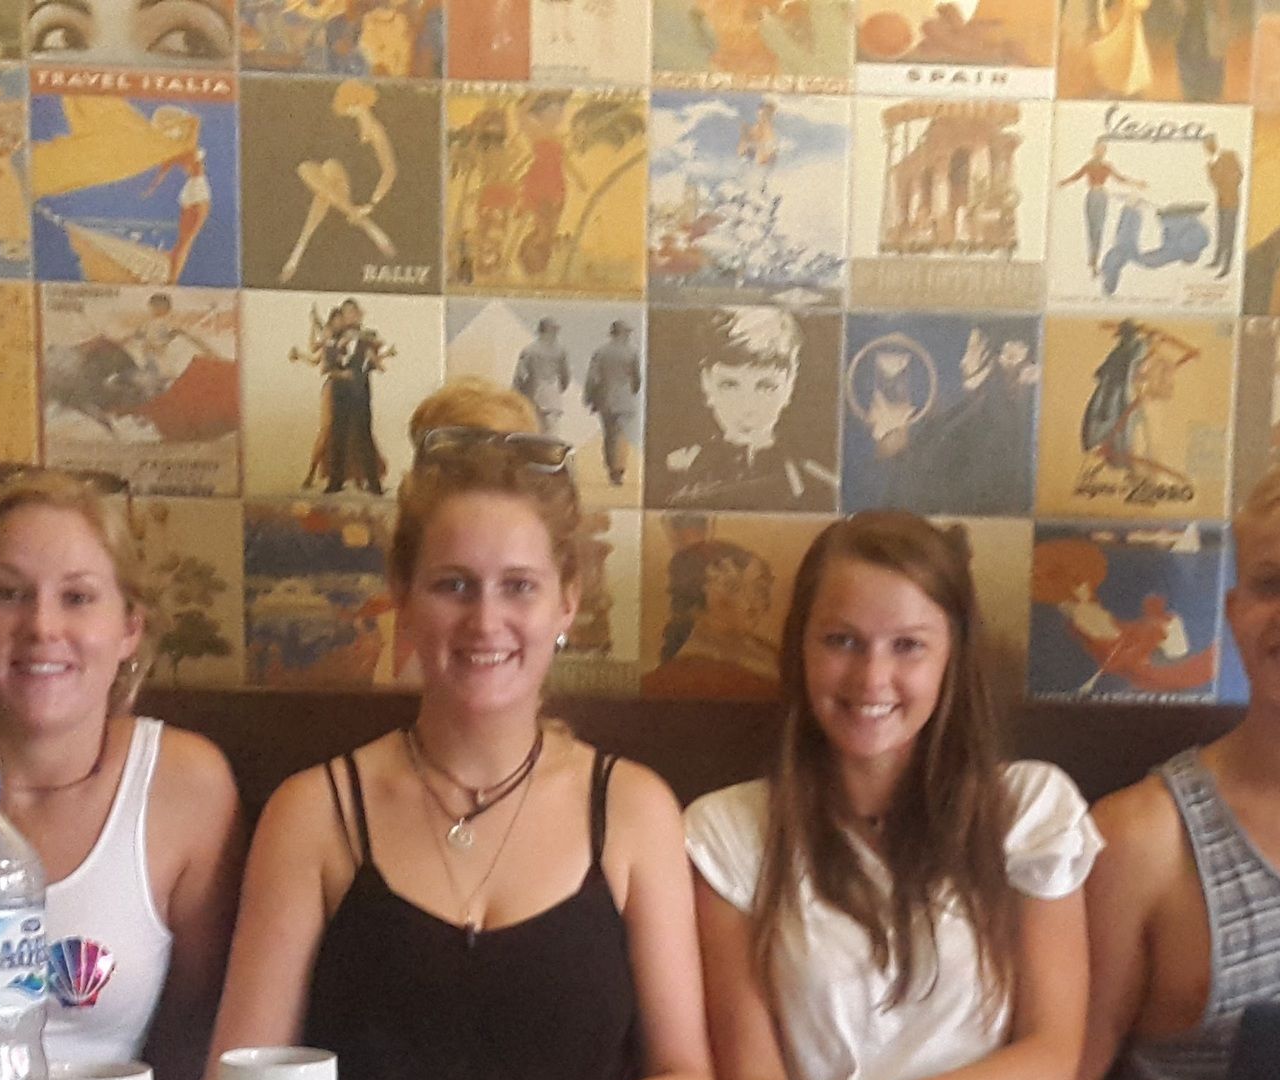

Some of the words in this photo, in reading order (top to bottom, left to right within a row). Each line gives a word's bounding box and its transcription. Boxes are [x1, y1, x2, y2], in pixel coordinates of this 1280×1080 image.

[36, 70, 131, 90] TRAVEL
[141, 74, 231, 94] ITALIA
[906, 68, 1009, 84] SPAIN
[1104, 101, 1207, 142] Vespa
